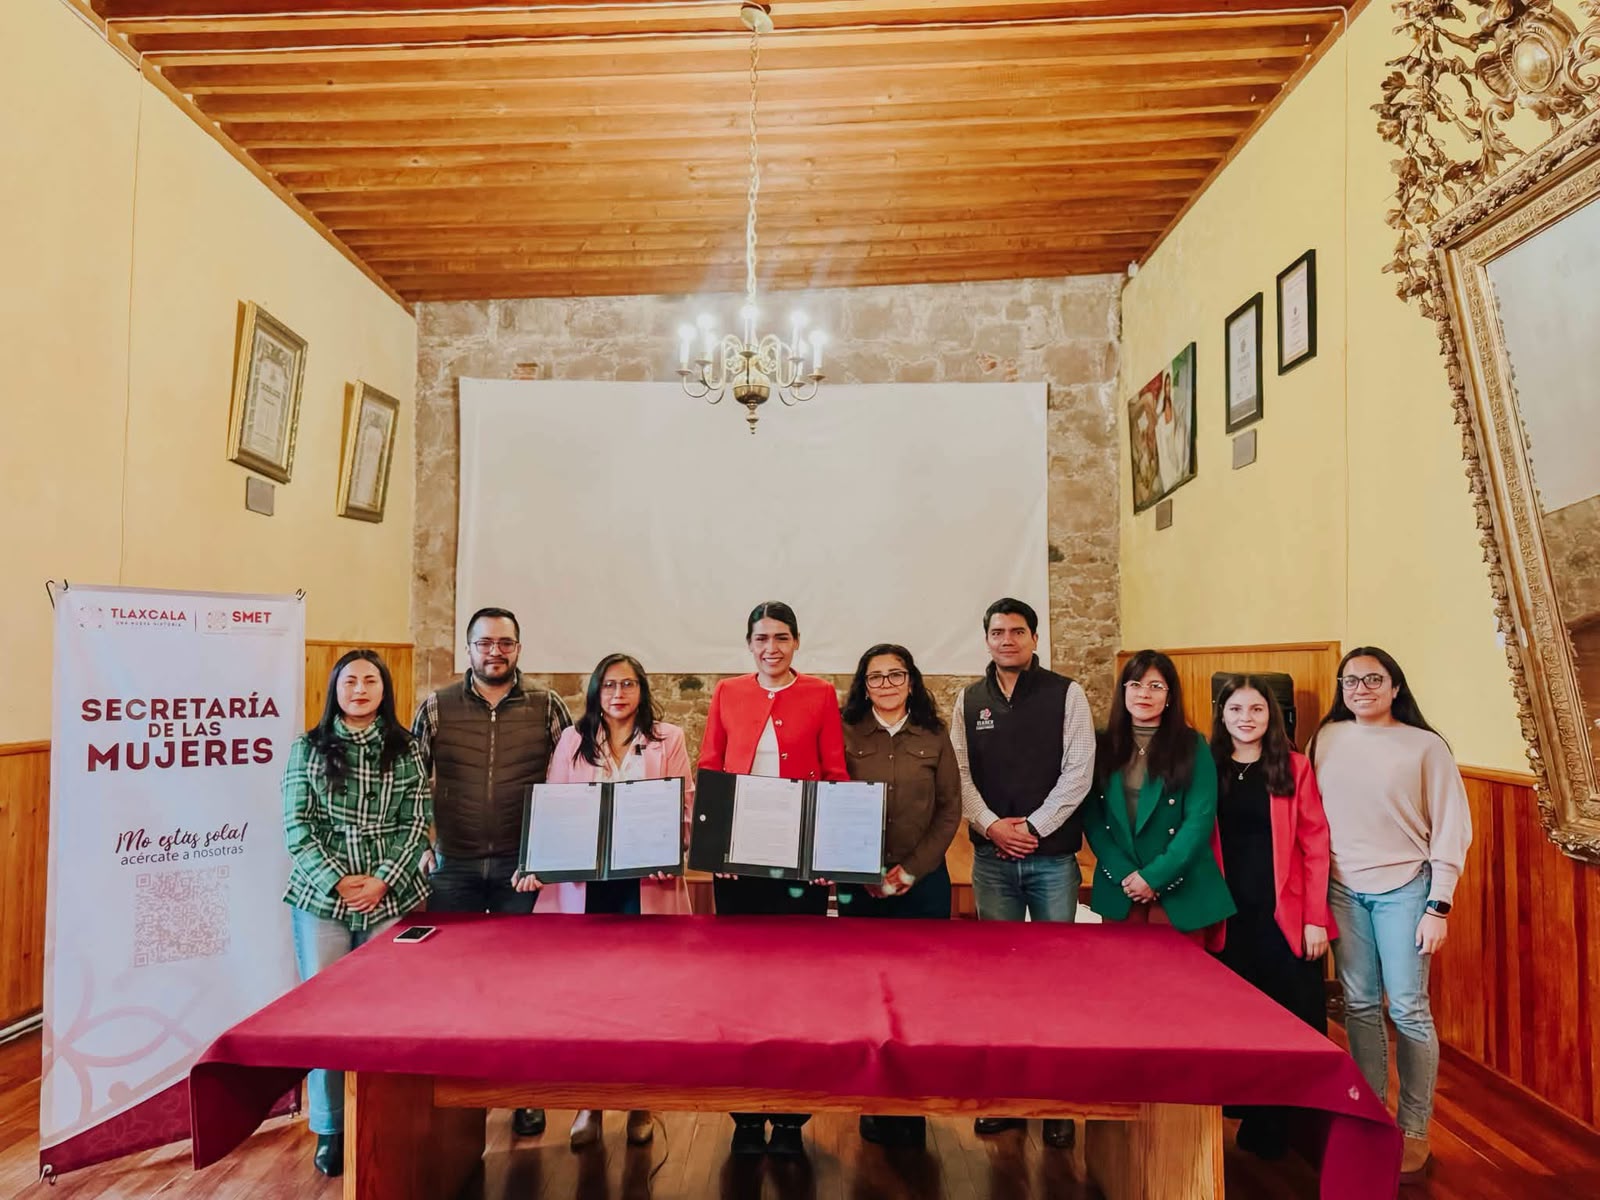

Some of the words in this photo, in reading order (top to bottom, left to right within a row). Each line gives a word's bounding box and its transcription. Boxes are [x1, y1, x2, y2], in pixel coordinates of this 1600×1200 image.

[110, 608, 187, 621] TLAXCALA
[232, 611, 272, 624] SMET
[81, 692, 280, 722] SECRETARÍA
[148, 722, 175, 739] DE
[182, 721, 222, 738] LAS
[87, 737, 273, 773] MUJERES
[115, 828, 153, 854] ¡No
[159, 828, 200, 851] estás
[204, 822, 248, 847] sola!
[120, 852, 179, 866] acércate
[183, 851, 190, 860] a
[193, 845, 244, 859] nosotras
